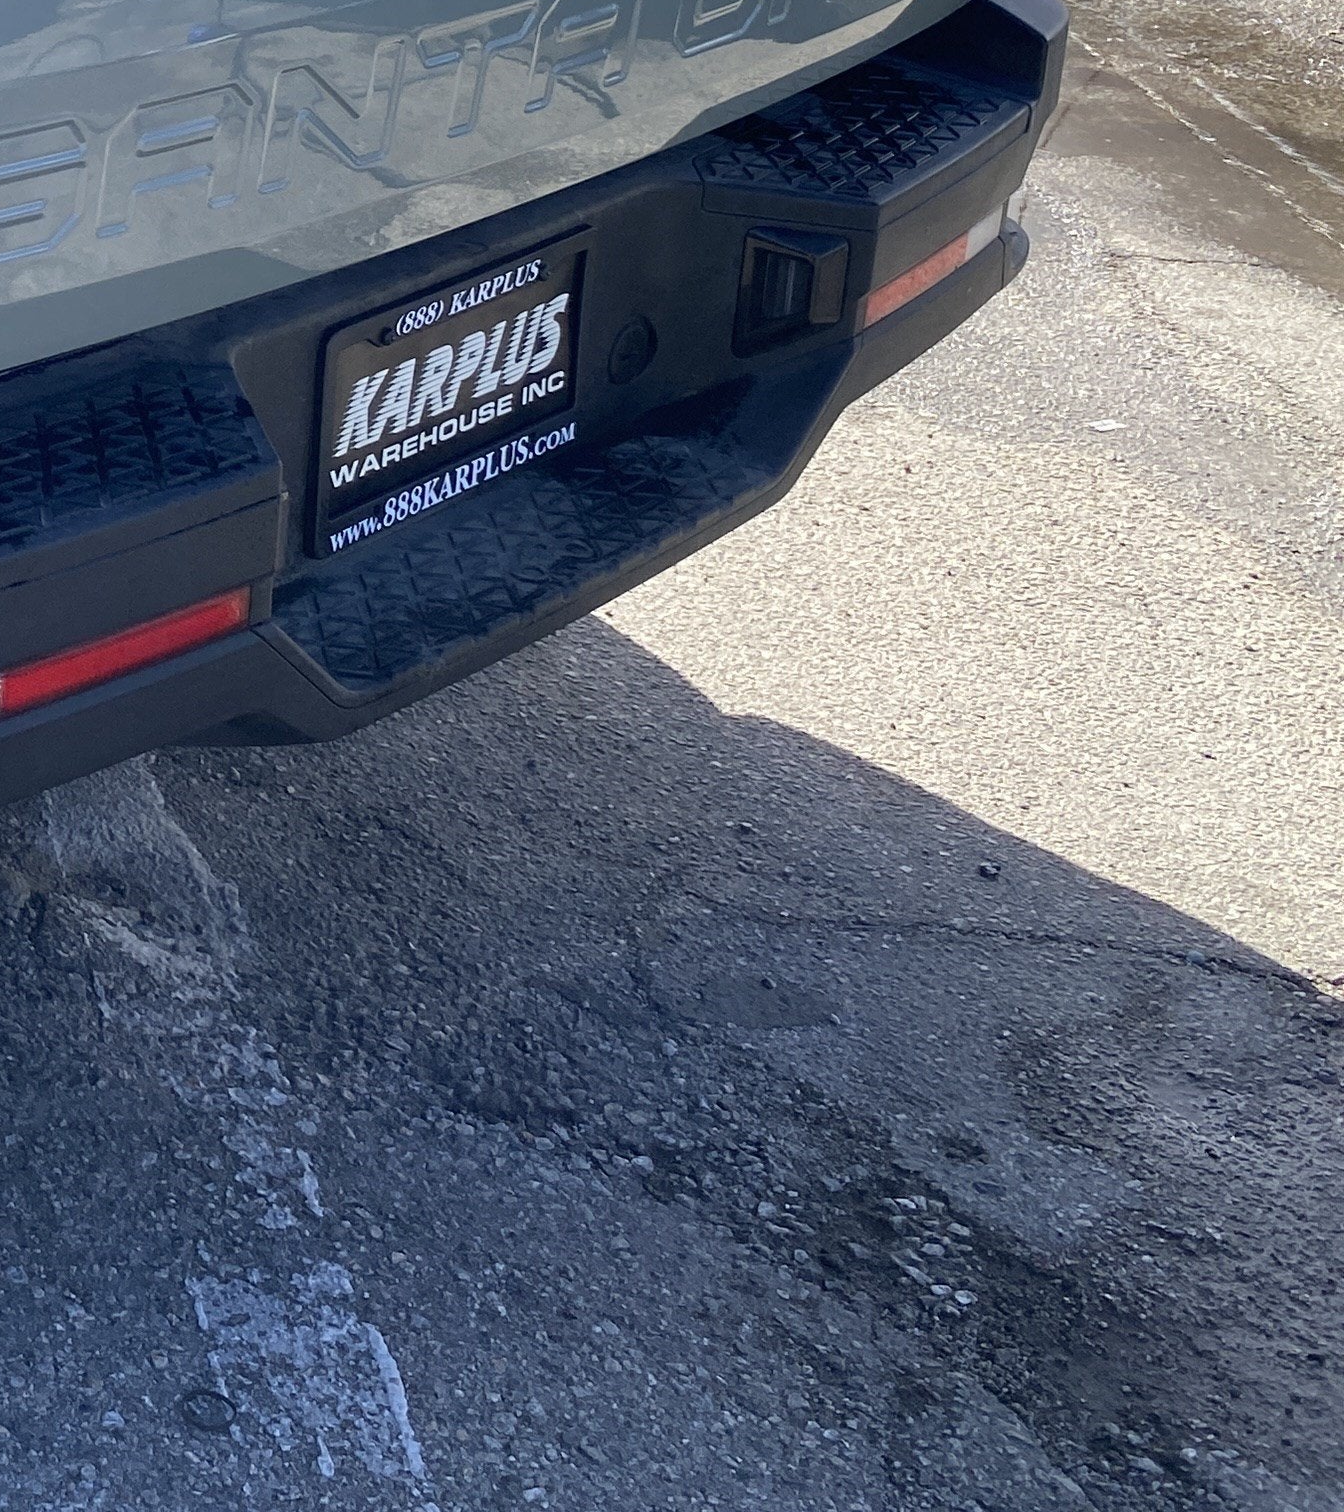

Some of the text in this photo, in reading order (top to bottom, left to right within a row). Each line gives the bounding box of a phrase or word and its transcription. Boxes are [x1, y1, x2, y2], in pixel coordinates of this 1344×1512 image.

[395, 258, 542, 337] (888) KARPLUS
[329, 370, 565, 489] WAREHOUSE INC
[332, 292, 570, 458] KARPLUS
